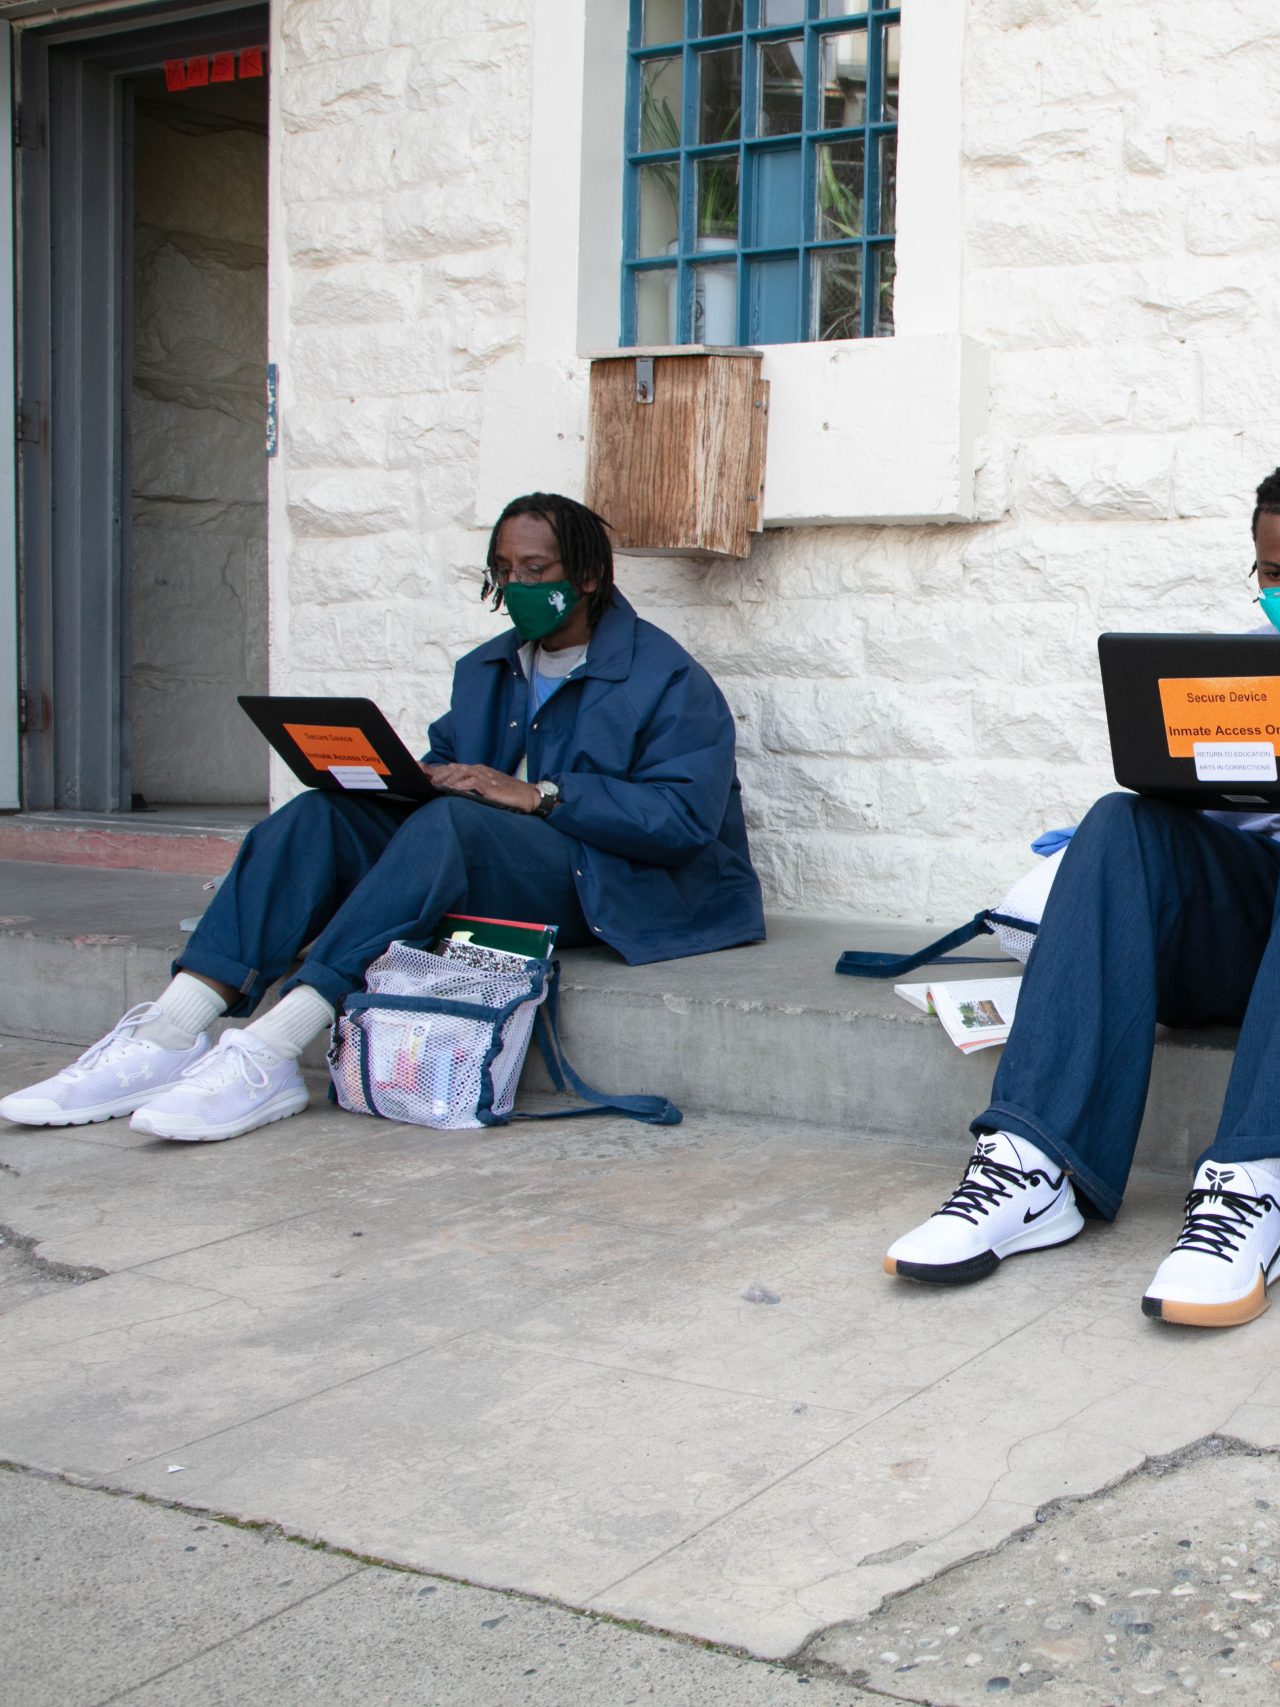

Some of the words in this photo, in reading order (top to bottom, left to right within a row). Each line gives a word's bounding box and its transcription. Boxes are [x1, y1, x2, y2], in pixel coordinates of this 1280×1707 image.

[1187, 692, 1225, 703] Secure
[1229, 691, 1267, 702] Device
[1168, 726, 1211, 736] Inmate
[1215, 725, 1261, 736] Access
